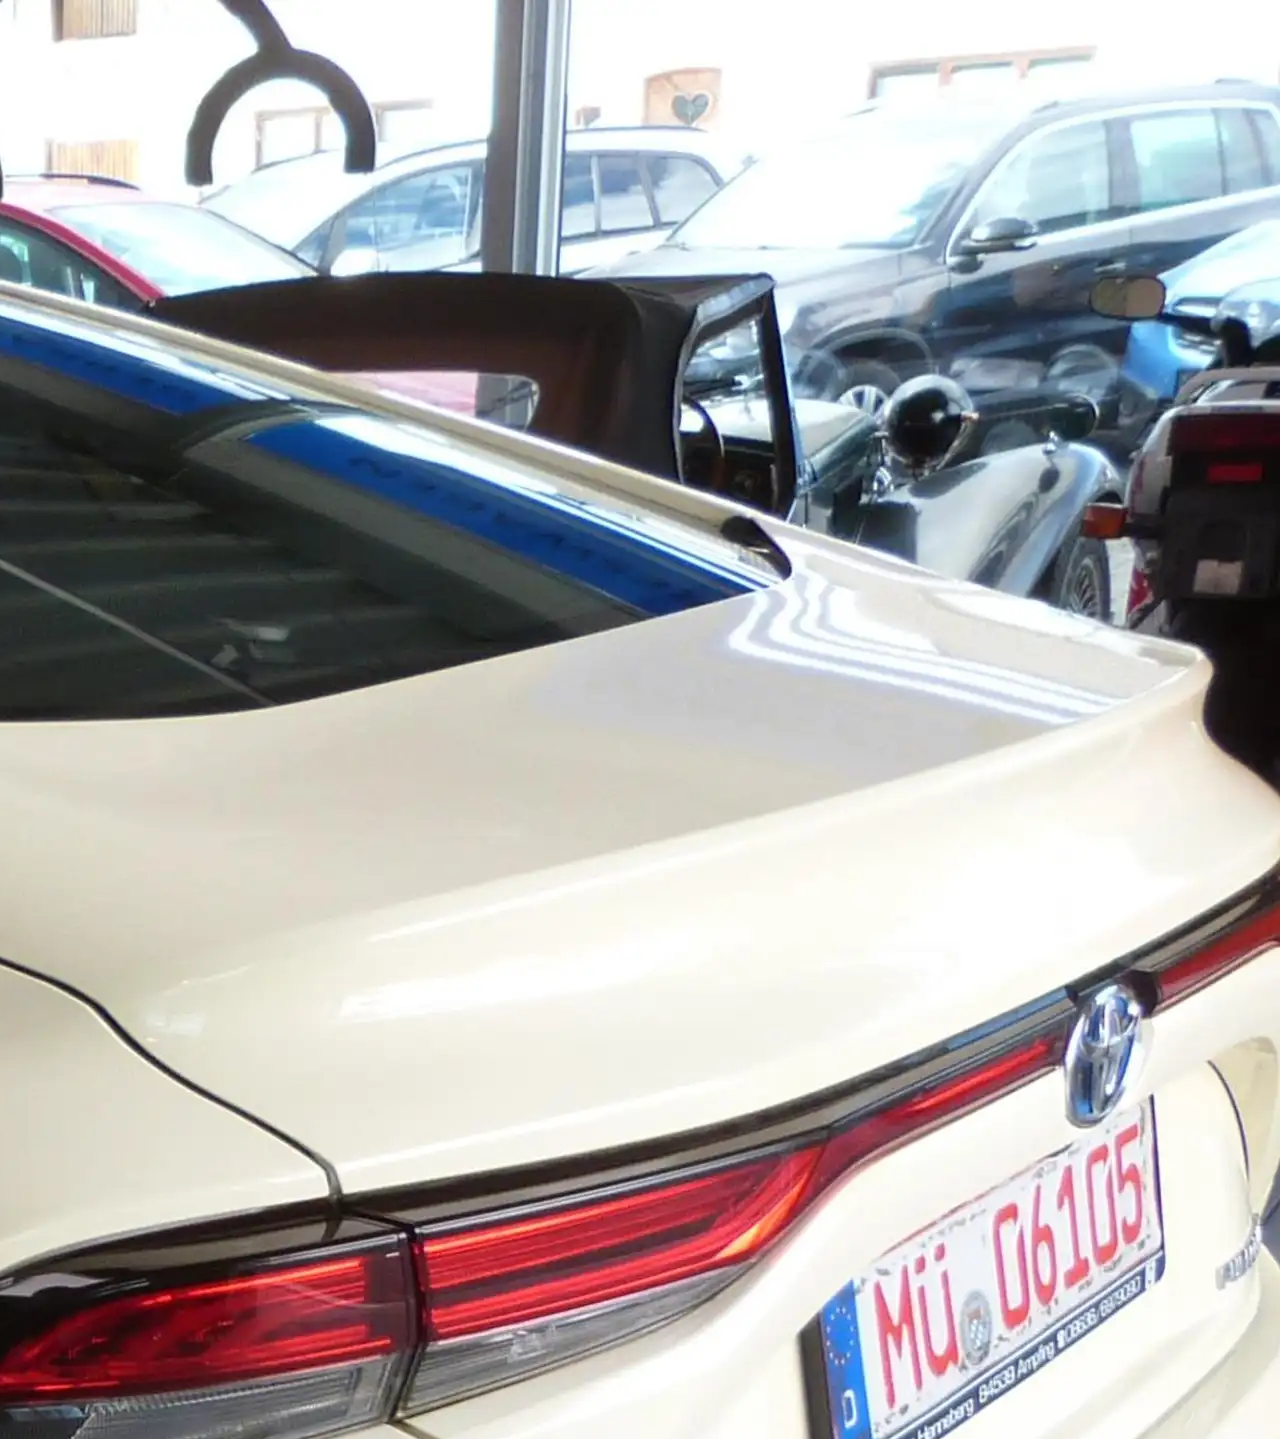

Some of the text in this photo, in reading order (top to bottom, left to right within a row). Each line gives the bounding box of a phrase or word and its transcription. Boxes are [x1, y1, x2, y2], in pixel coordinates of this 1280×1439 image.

[873, 1242, 960, 1410] MÜ
[992, 1122, 1144, 1330] 06105
[842, 1388, 858, 1429] D
